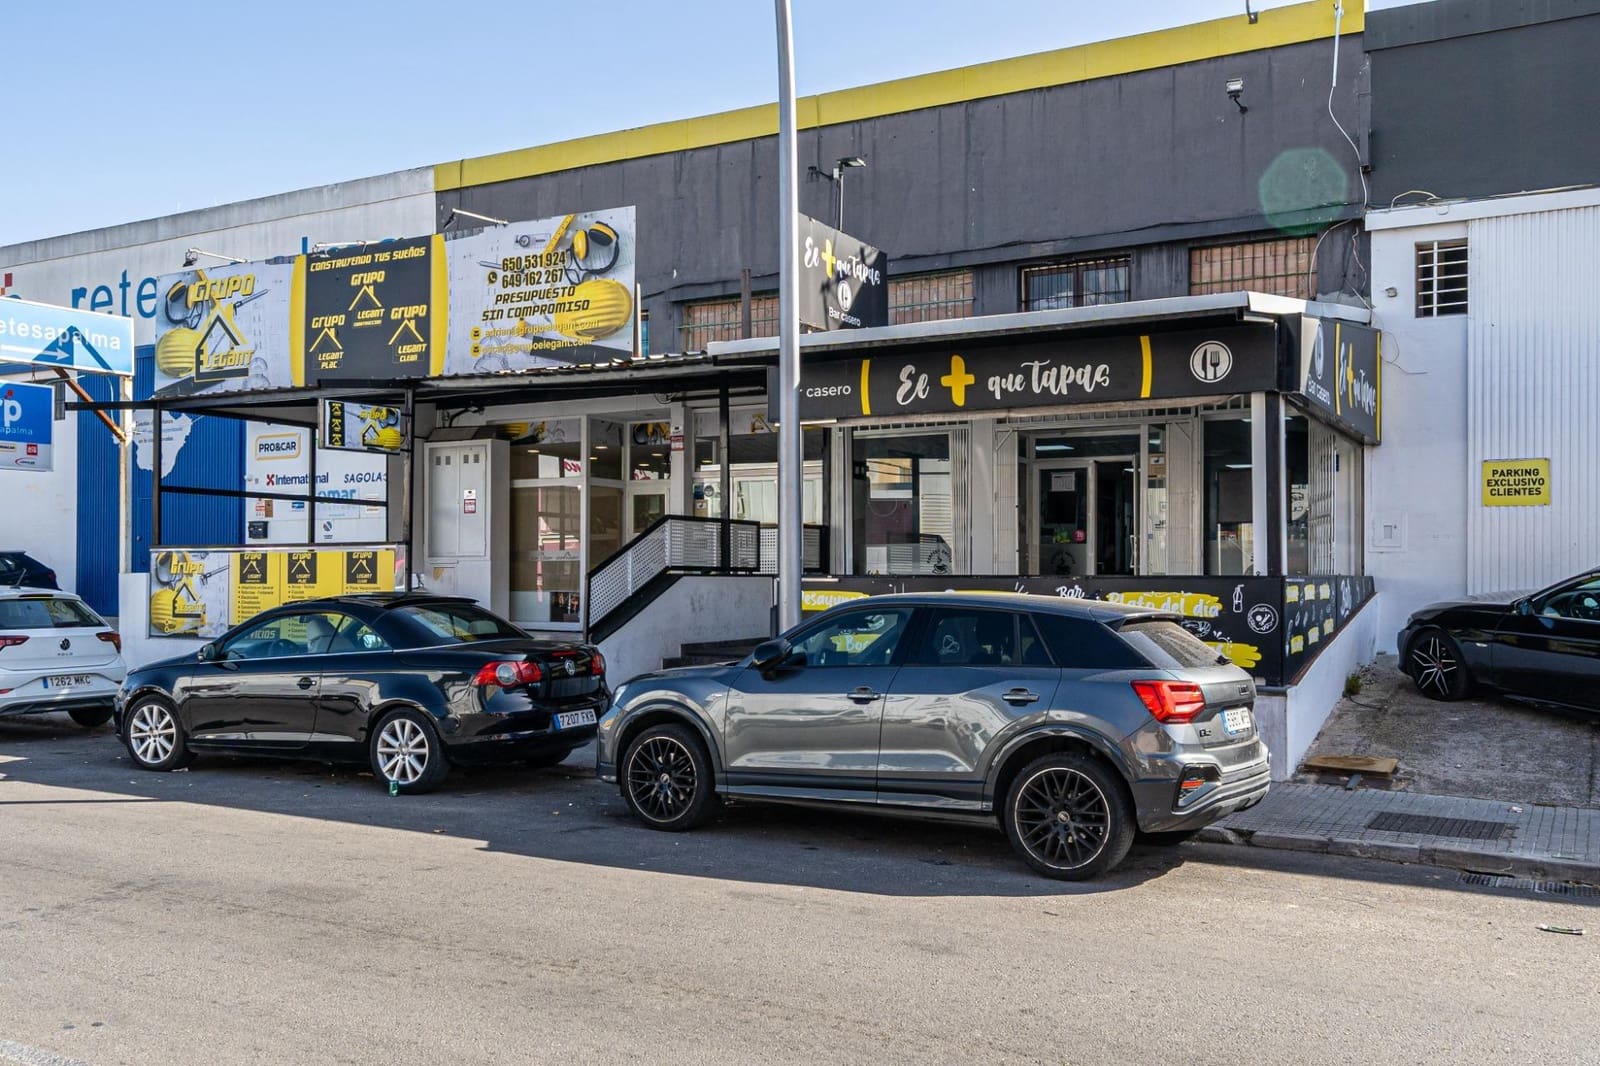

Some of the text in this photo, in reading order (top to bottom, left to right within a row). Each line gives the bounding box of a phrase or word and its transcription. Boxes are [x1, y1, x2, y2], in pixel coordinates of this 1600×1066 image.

[310, 246, 426, 272] CONSTRUYENDO TUS SUEÑOS
[502, 251, 566, 272] 650 531 924
[804, 236, 820, 268] El
[837, 258, 852, 279] que
[350, 270, 385, 286] GRUPO
[501, 268, 564, 289] 649 162 267
[193, 274, 255, 302] GRUPO
[494, 285, 577, 305] PRESUPUESTO
[391, 304, 428, 320] GRUPO
[481, 299, 590, 321] SIN COMPROMISO
[828, 306, 861, 327] Bar casero
[311, 314, 346, 329] GRUPO
[806, 383, 851, 399] casero
[896, 364, 930, 406] El
[988, 374, 1026, 400] que
[258, 441, 297, 452] PRO&CAR
[275, 472, 329, 485] Internatnal
[344, 472, 382, 484] SAGOLA
[1492, 468, 1540, 477] PARKING
[1487, 477, 1545, 487] EXCLUSIVO
[1489, 487, 1542, 497] CLIENTES
[1056, 585, 1085, 599] Bar
[1108, 592, 1220, 617] Plato del día
[50, 677, 73, 687] 1262
[560, 713, 579, 727] 7207
